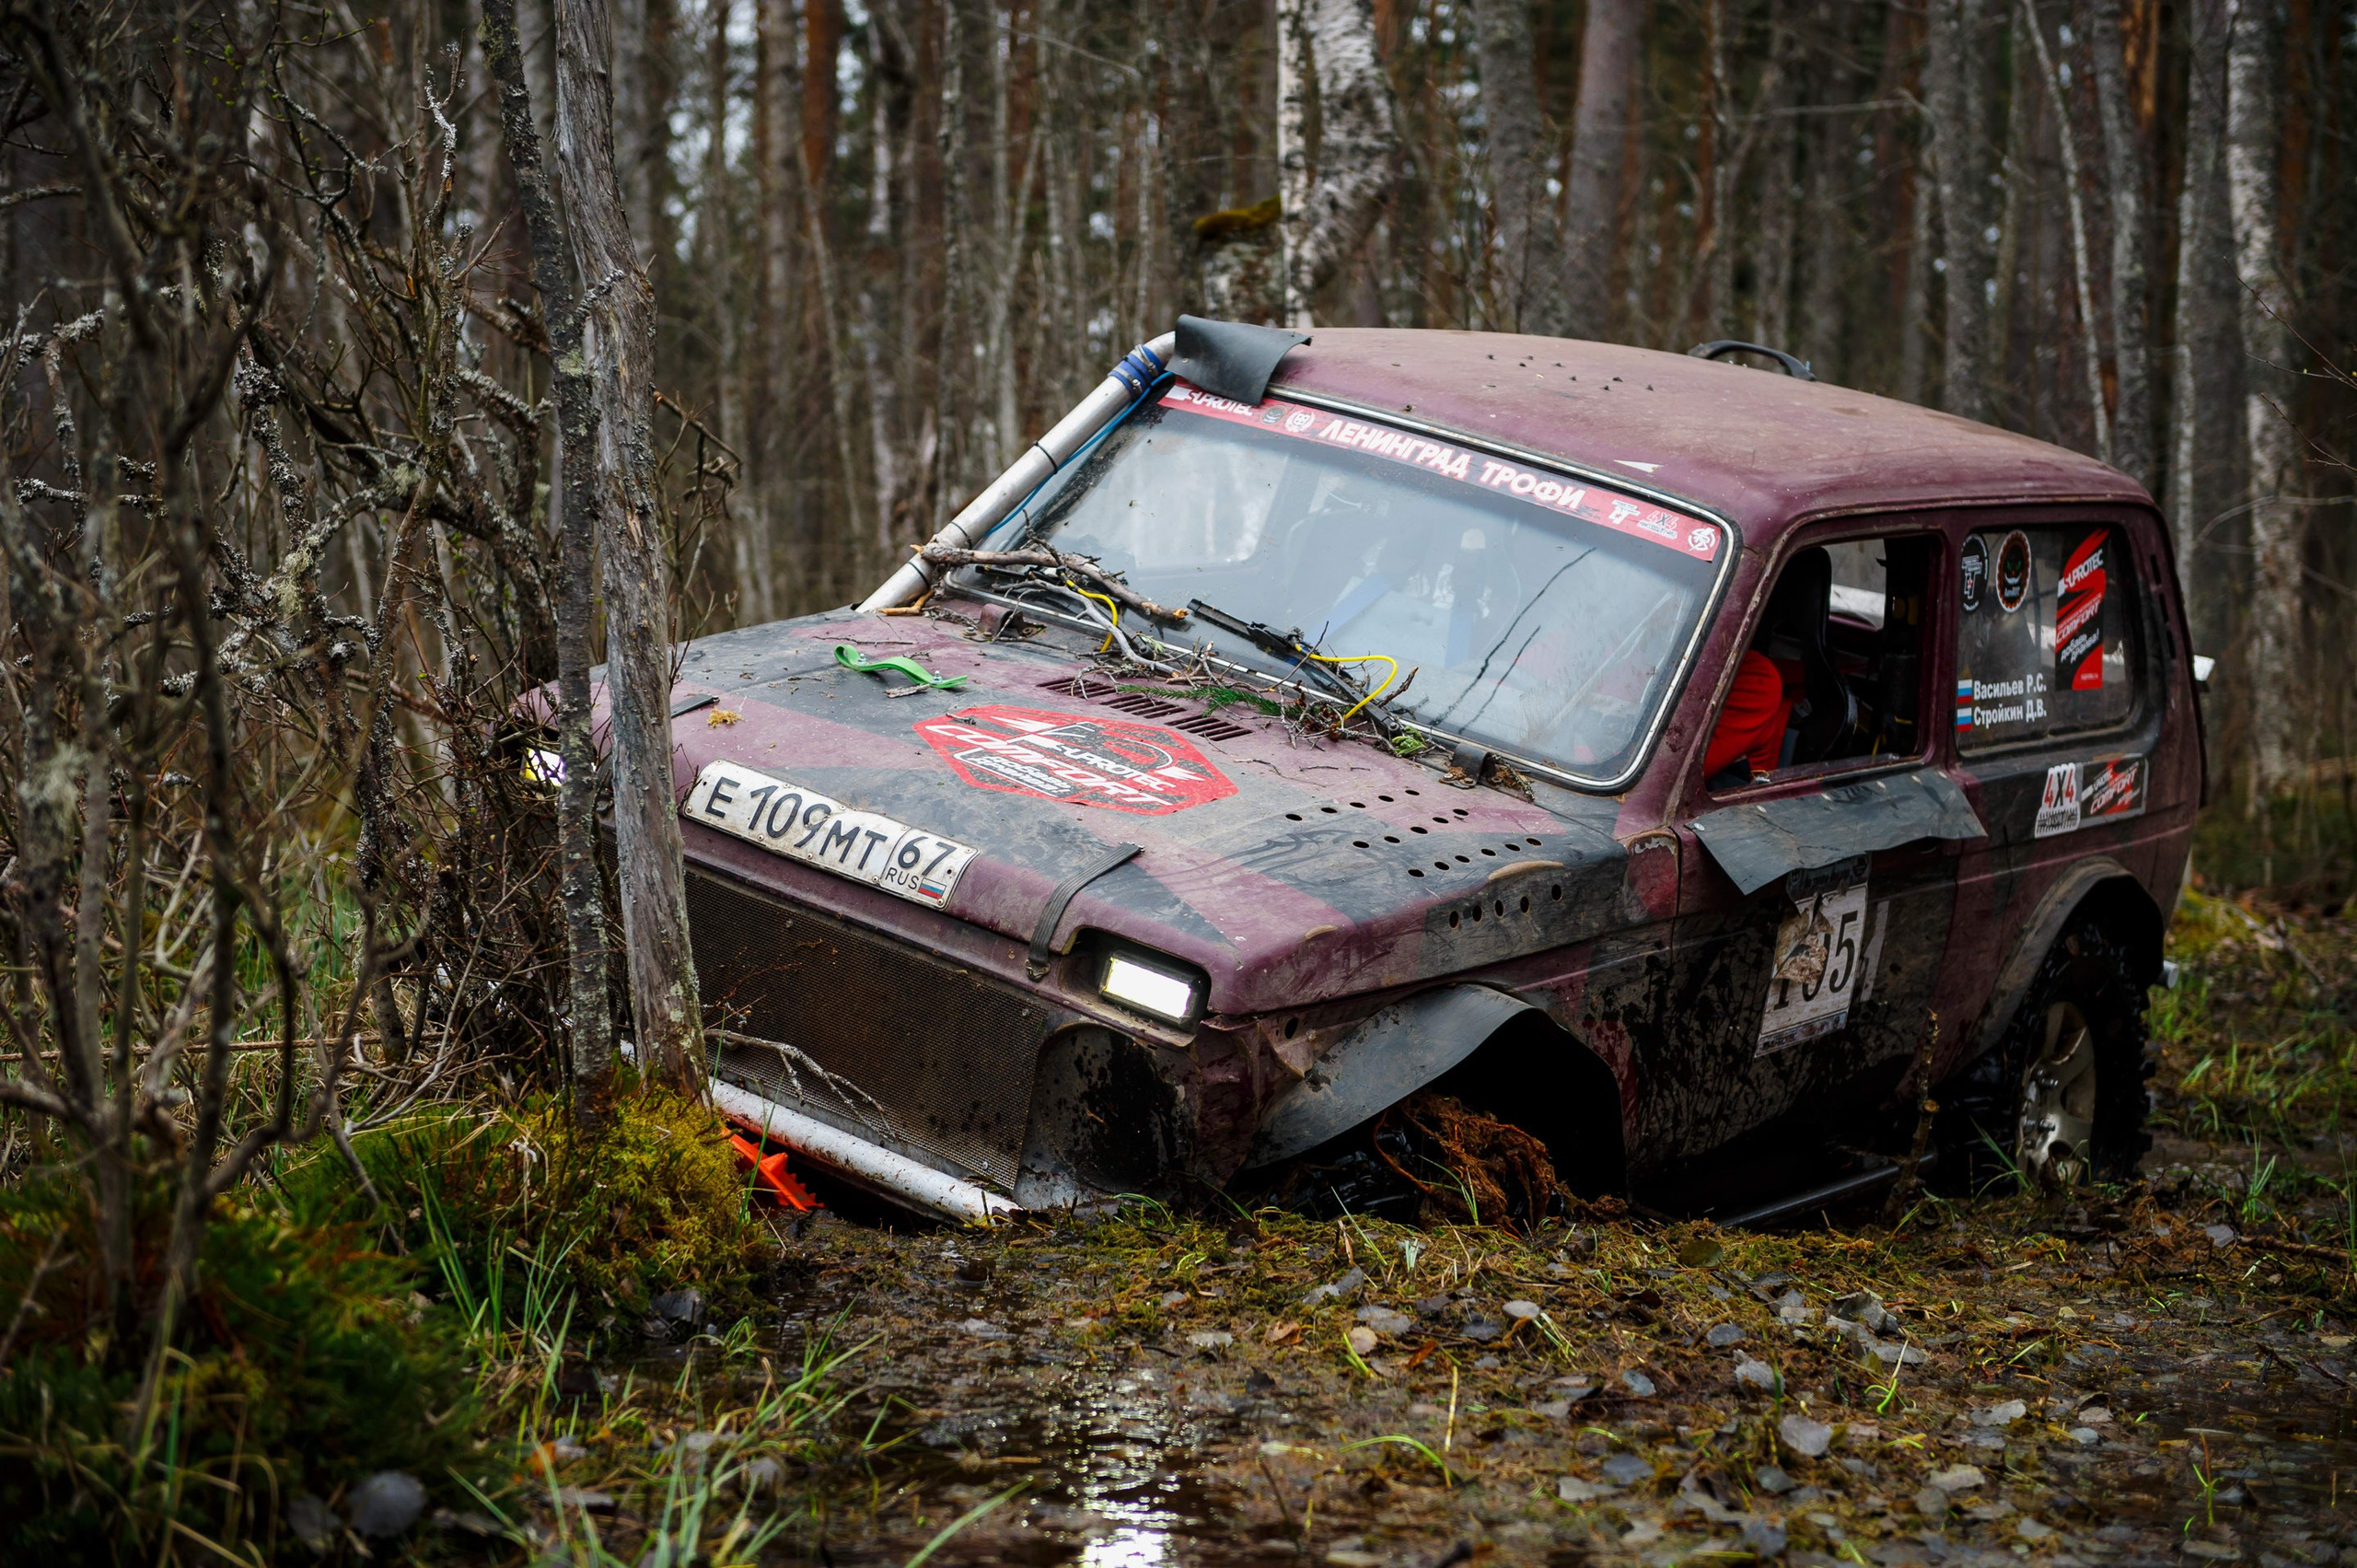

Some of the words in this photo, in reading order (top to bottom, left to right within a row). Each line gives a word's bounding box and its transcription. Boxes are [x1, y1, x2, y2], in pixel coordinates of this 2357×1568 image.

[1318, 420, 1470, 479] ЛЕНИНГРАД
[1480, 461, 1585, 509] ТРОФИ
[1973, 679, 2024, 701] Васильев
[2026, 672, 2047, 693] Р.С.
[1973, 703, 2024, 729] Стройкин
[2026, 698, 2047, 723] Д.В.
[925, 726, 1174, 807] COMFORT
[897, 834, 958, 877] 67
[885, 866, 920, 890] RUS
